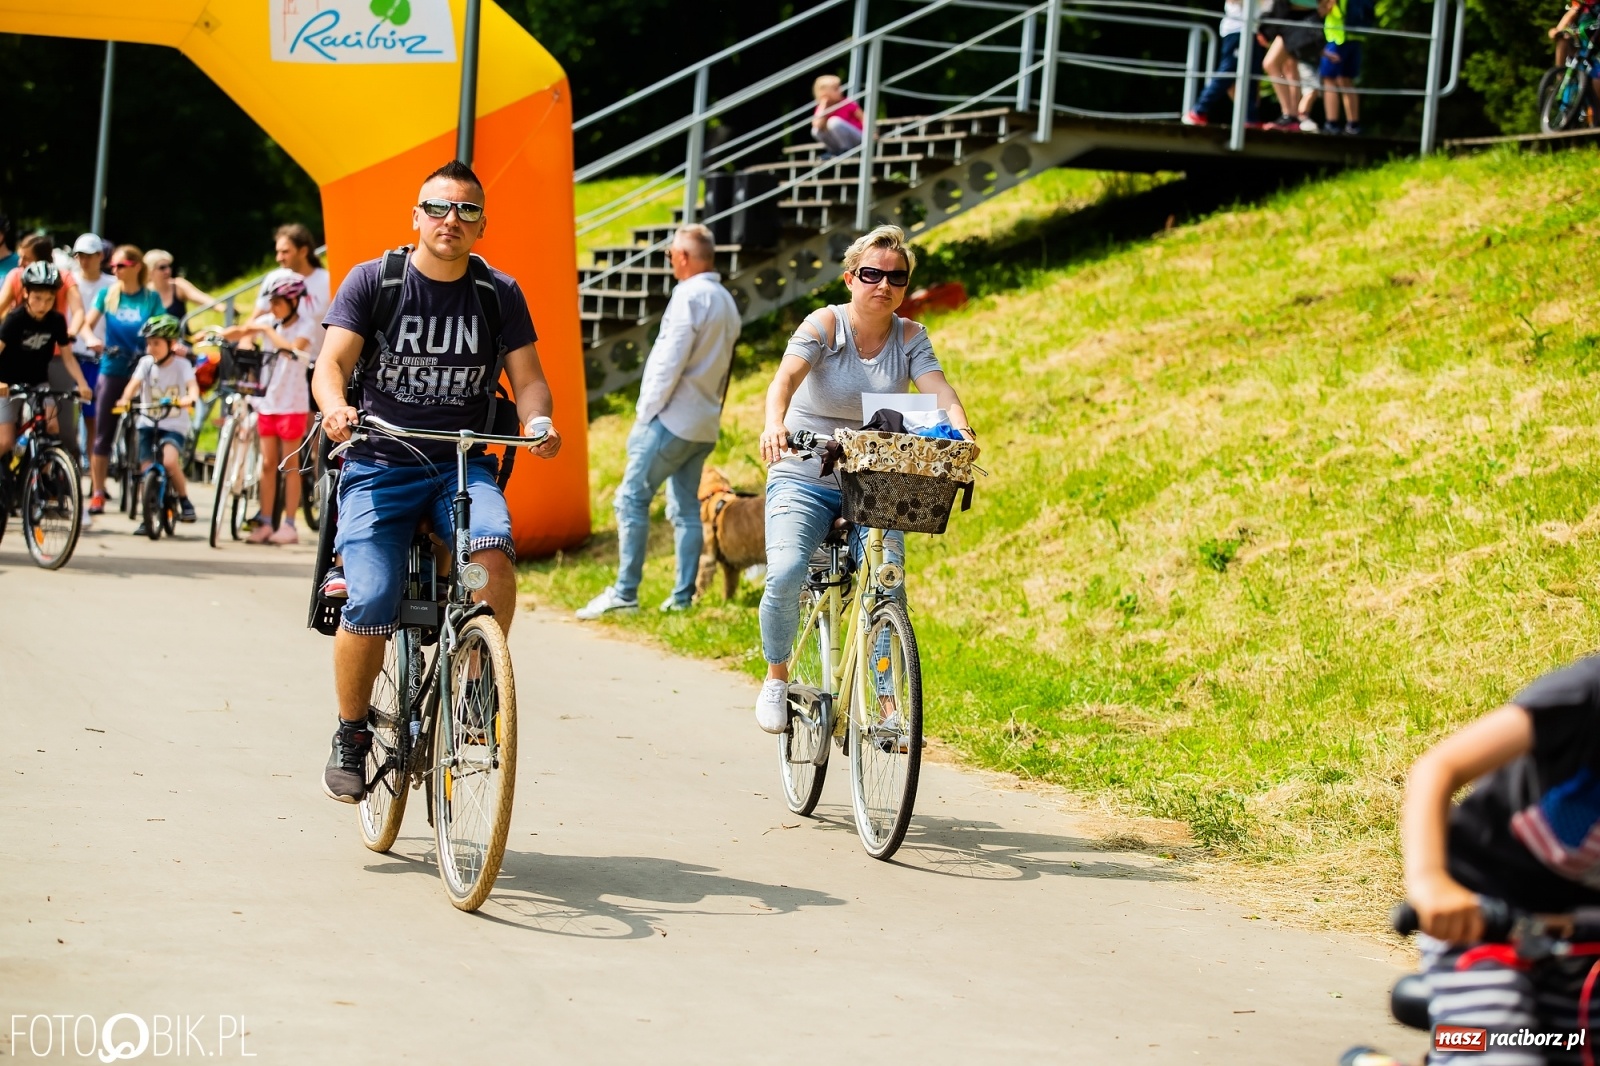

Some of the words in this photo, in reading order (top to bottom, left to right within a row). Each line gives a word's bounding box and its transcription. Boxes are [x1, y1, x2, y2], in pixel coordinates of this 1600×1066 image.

[22, 332, 52, 350] 4F
[395, 314, 479, 355] RUN
[402, 356, 438, 366] WINNER
[377, 363, 484, 398] FASTER
